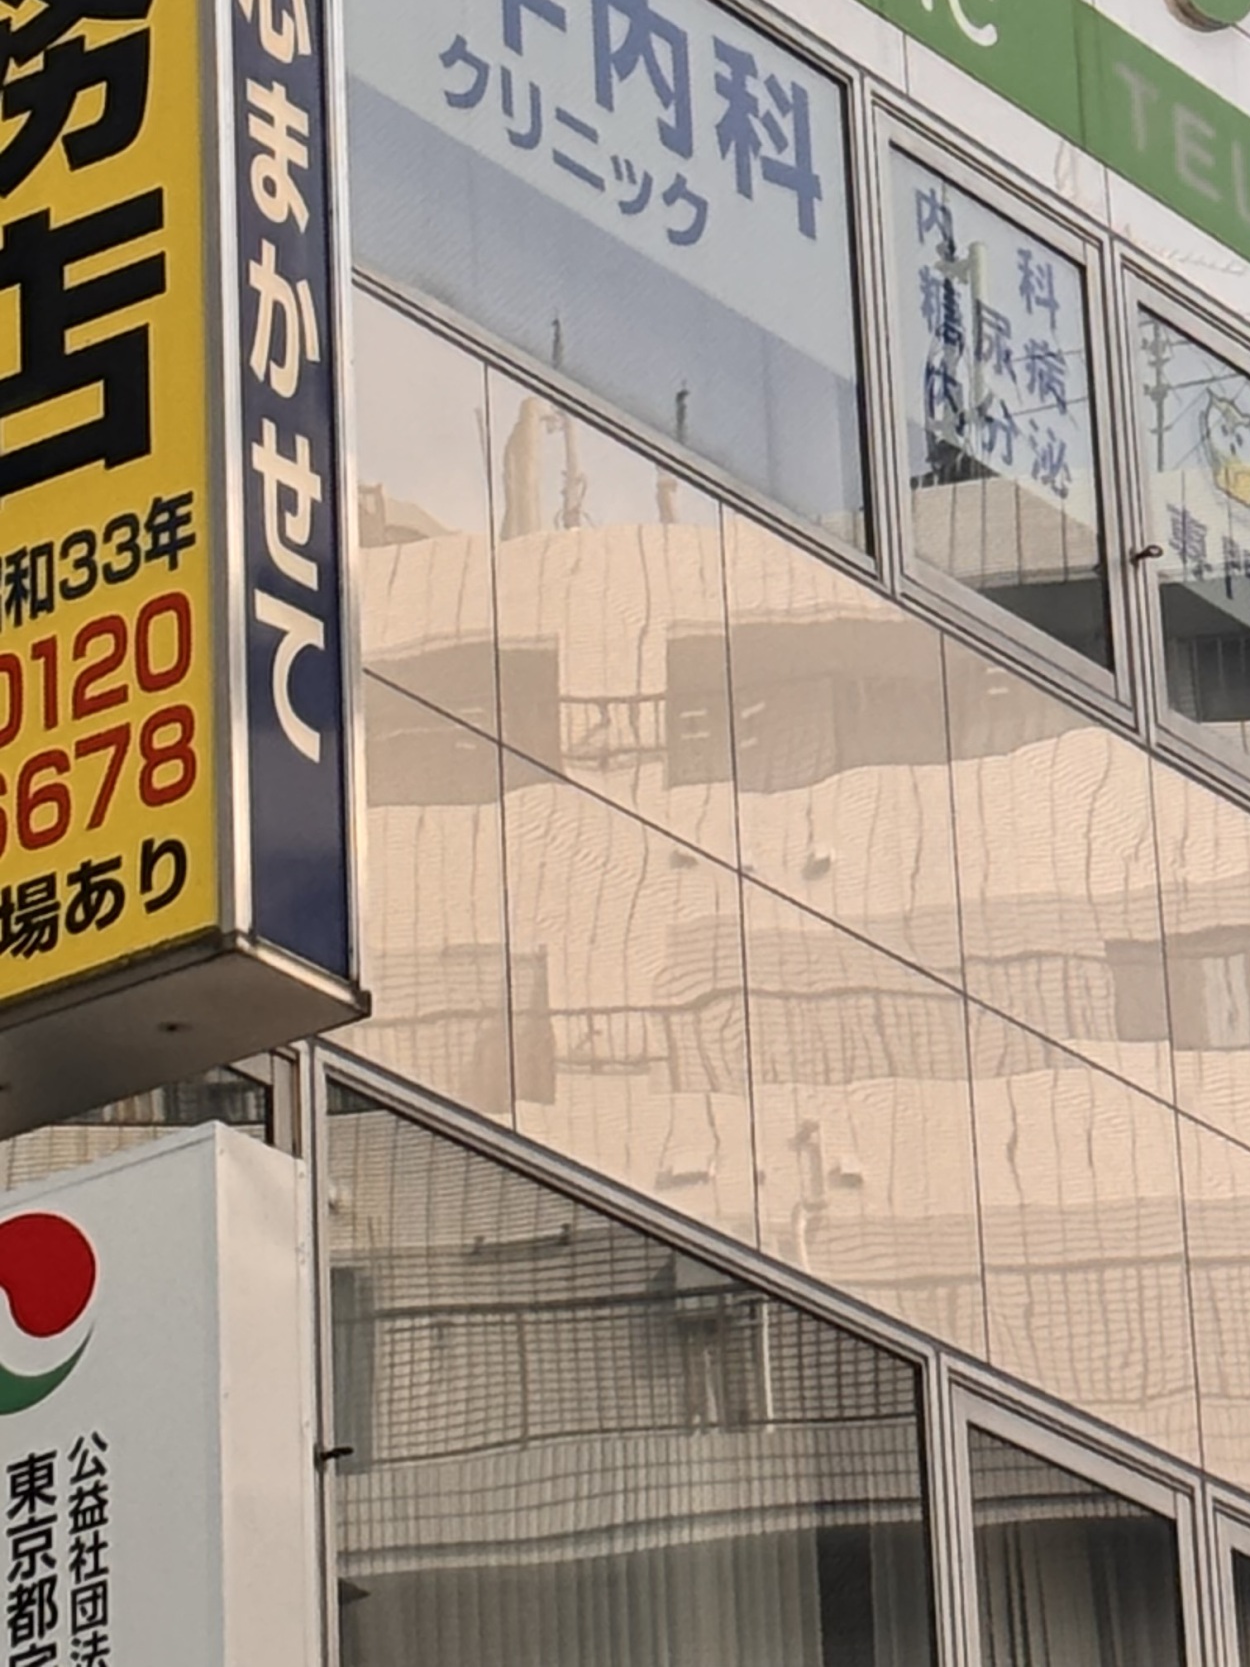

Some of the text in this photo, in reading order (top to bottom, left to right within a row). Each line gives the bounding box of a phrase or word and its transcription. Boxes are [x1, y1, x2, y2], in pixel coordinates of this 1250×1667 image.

[438, 33, 710, 248] クリニック
[0, 491, 197, 628] 和33年
[0, 704, 197, 864] 678
[67, 1430, 111, 1667] 公益社団法
